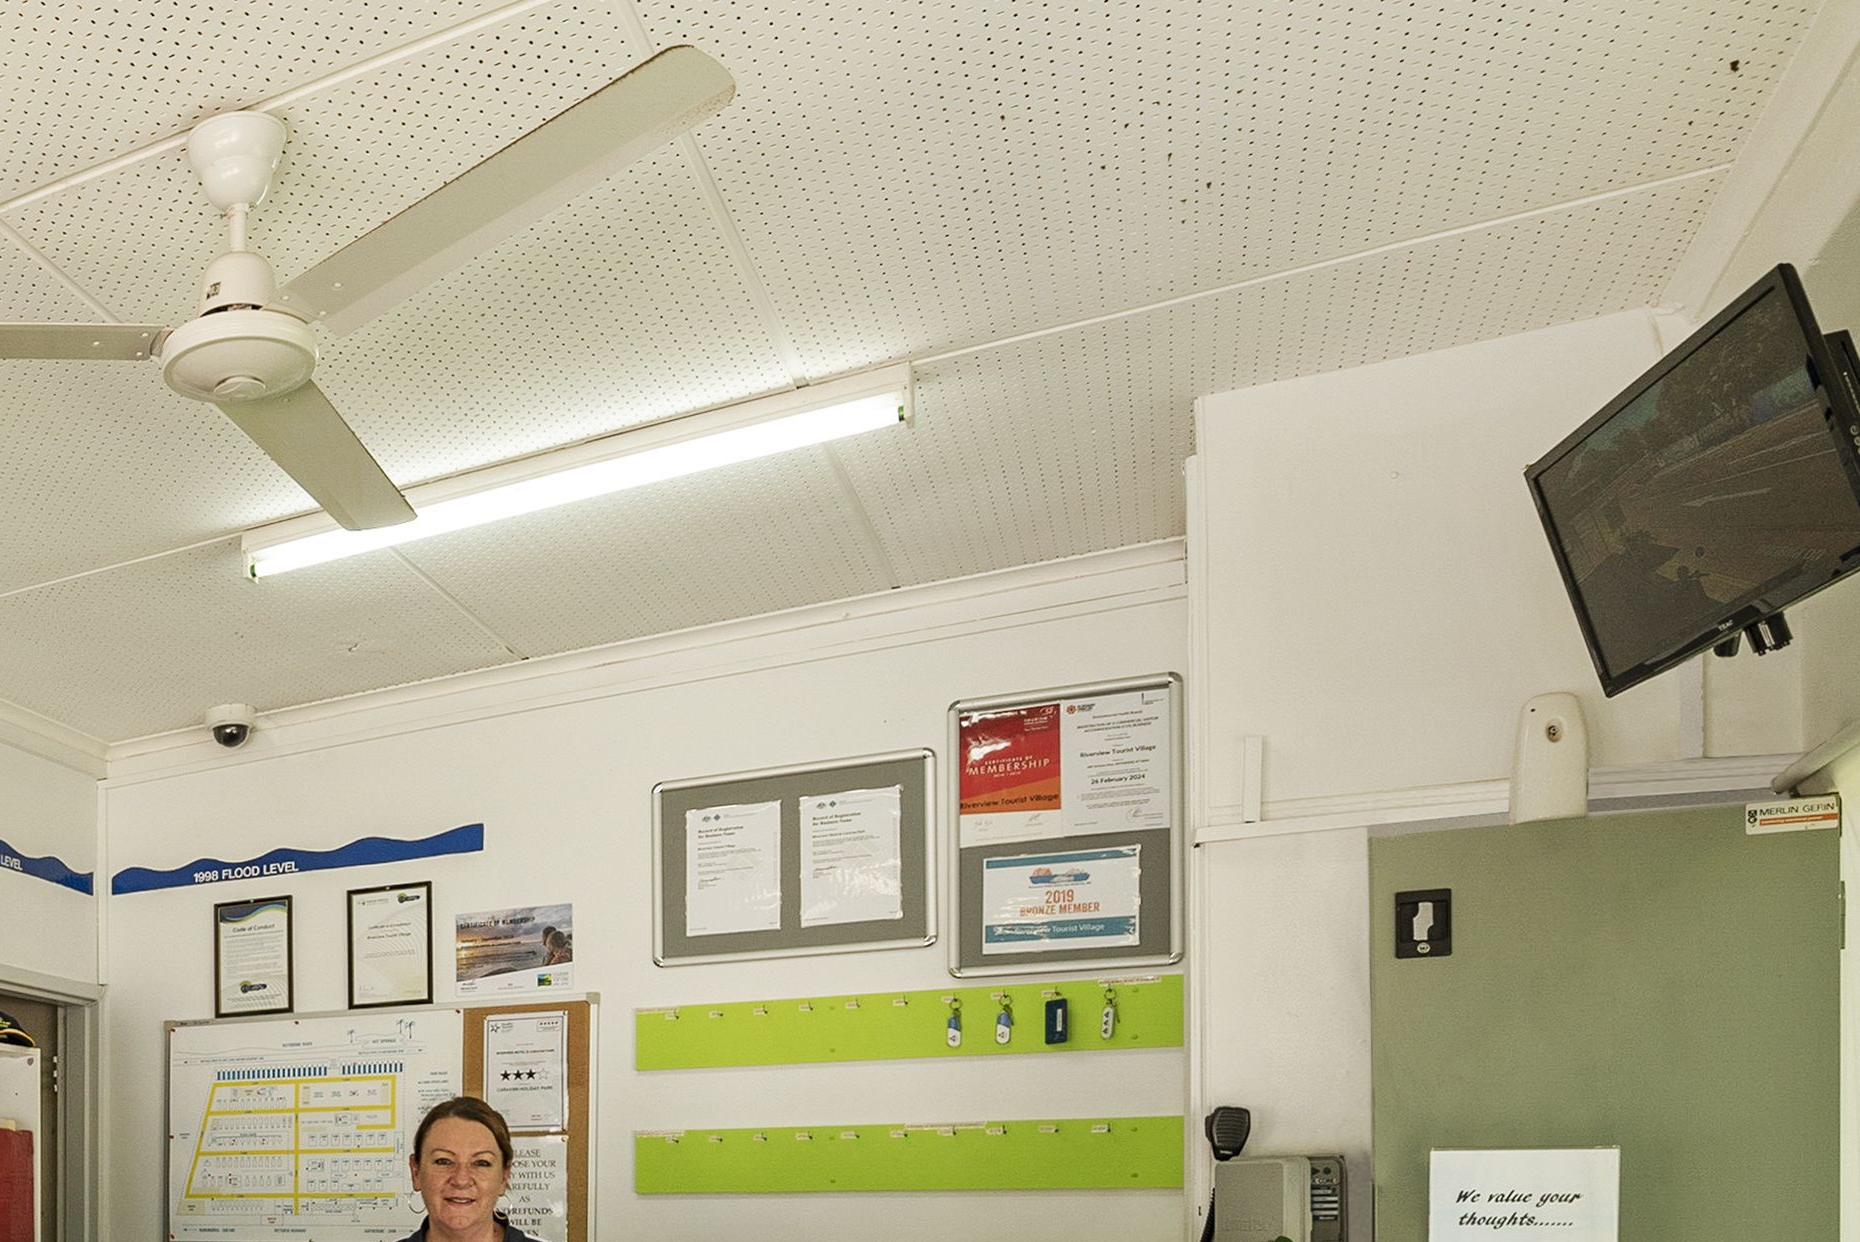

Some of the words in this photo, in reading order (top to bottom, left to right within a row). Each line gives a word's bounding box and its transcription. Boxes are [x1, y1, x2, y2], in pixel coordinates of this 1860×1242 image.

[1135, 745, 1156, 753] Village
[968, 759, 1050, 776] MEMBERSHIP
[1100, 776, 1128, 784] February
[1759, 804, 1799, 817] MERLIN
[0, 854, 22, 871] LEVEL
[194, 871, 218, 882] 1998
[222, 867, 260, 880] FLOOD
[263, 861, 299, 874] LEVEL
[1045, 889, 1074, 904] 2019
[1059, 902, 1100, 914] MEMBER
[1053, 924, 1077, 933] Tourist
[1079, 923, 1105, 931] Village
[1456, 1190, 1480, 1203] We
[1487, 1190, 1532, 1203] value
[1536, 1193, 1581, 1207] your
